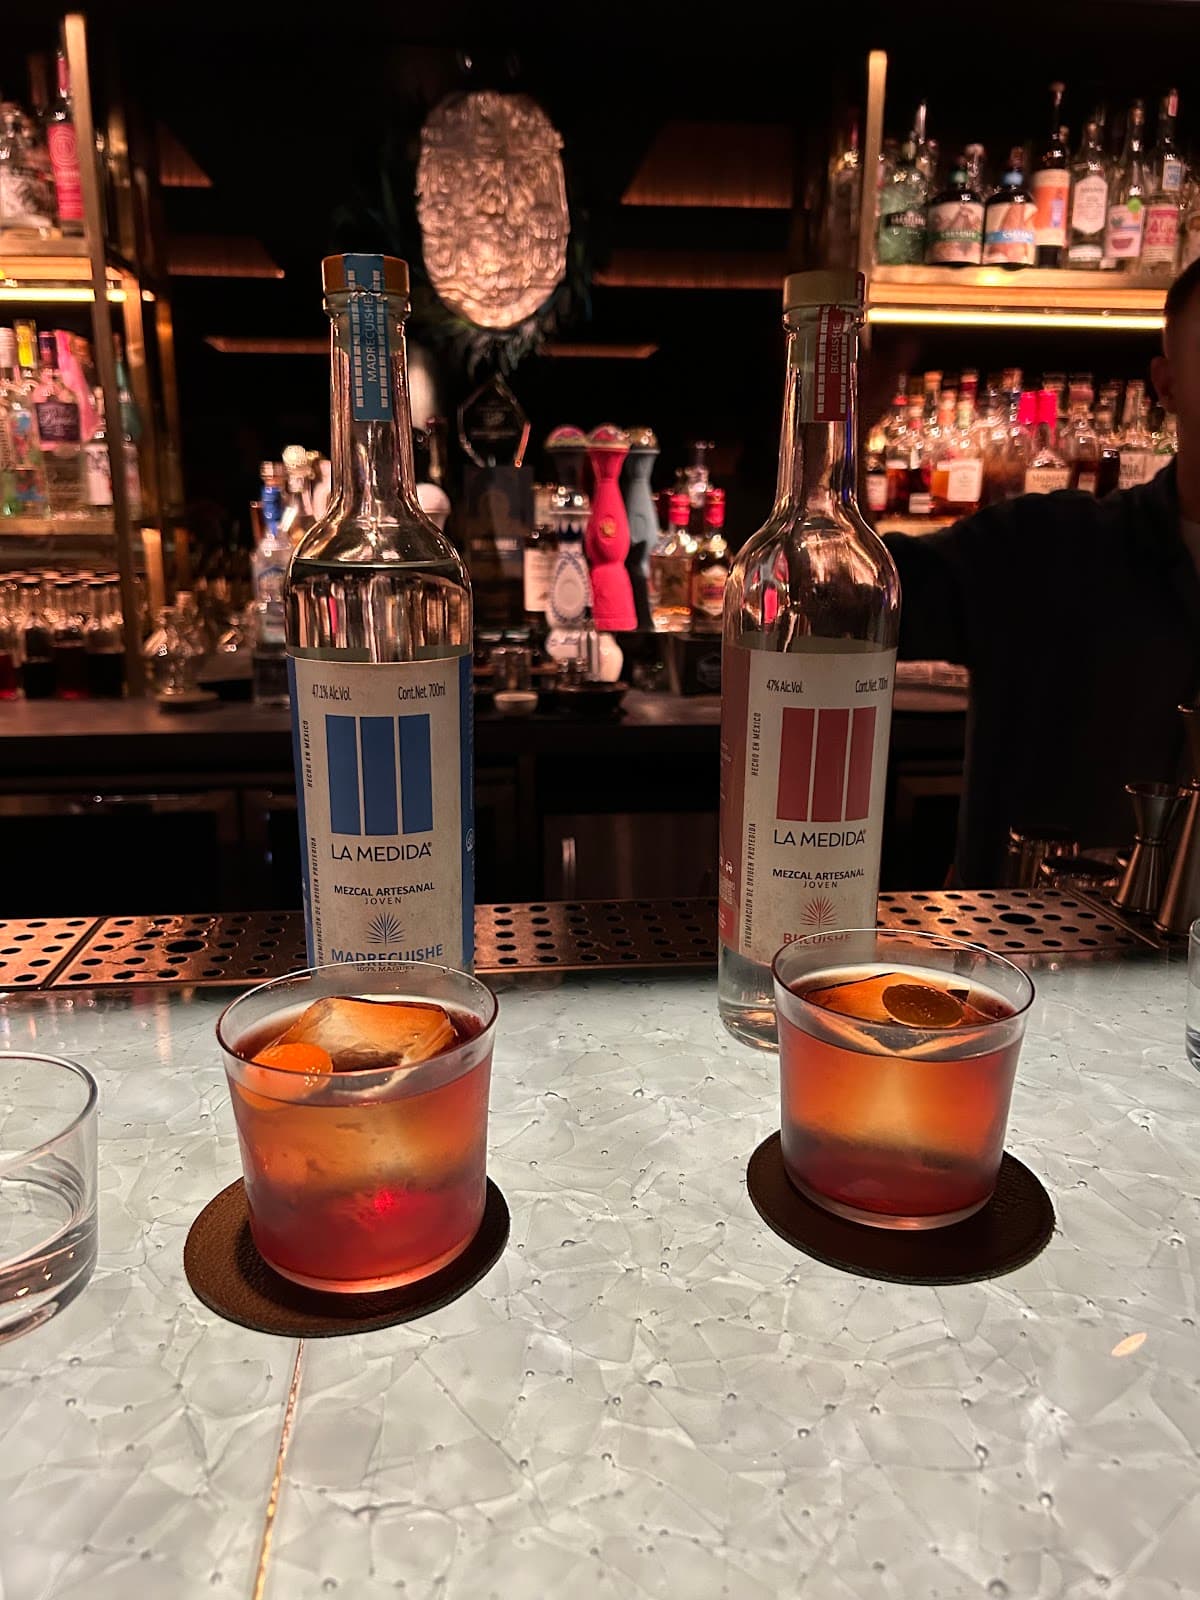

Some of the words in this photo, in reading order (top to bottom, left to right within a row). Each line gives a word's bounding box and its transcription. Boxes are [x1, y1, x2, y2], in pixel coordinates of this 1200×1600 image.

[363, 293, 377, 382] MADRECUISHE
[830, 323, 842, 374] BICUISHE
[766, 679, 780, 692] 47%
[752, 742, 760, 751] EN
[305, 752, 311, 761] EN
[751, 753, 760, 777] HECHO
[773, 829, 796, 846] LA
[331, 842, 353, 862] LA
[772, 868, 813, 880] MEZCAL
[815, 868, 864, 881] ARTESANAL
[334, 884, 373, 897] MEZCAL
[376, 882, 435, 897] ARTESANAL
[803, 881, 838, 889] JOVEN
[365, 896, 402, 905] JOVEN
